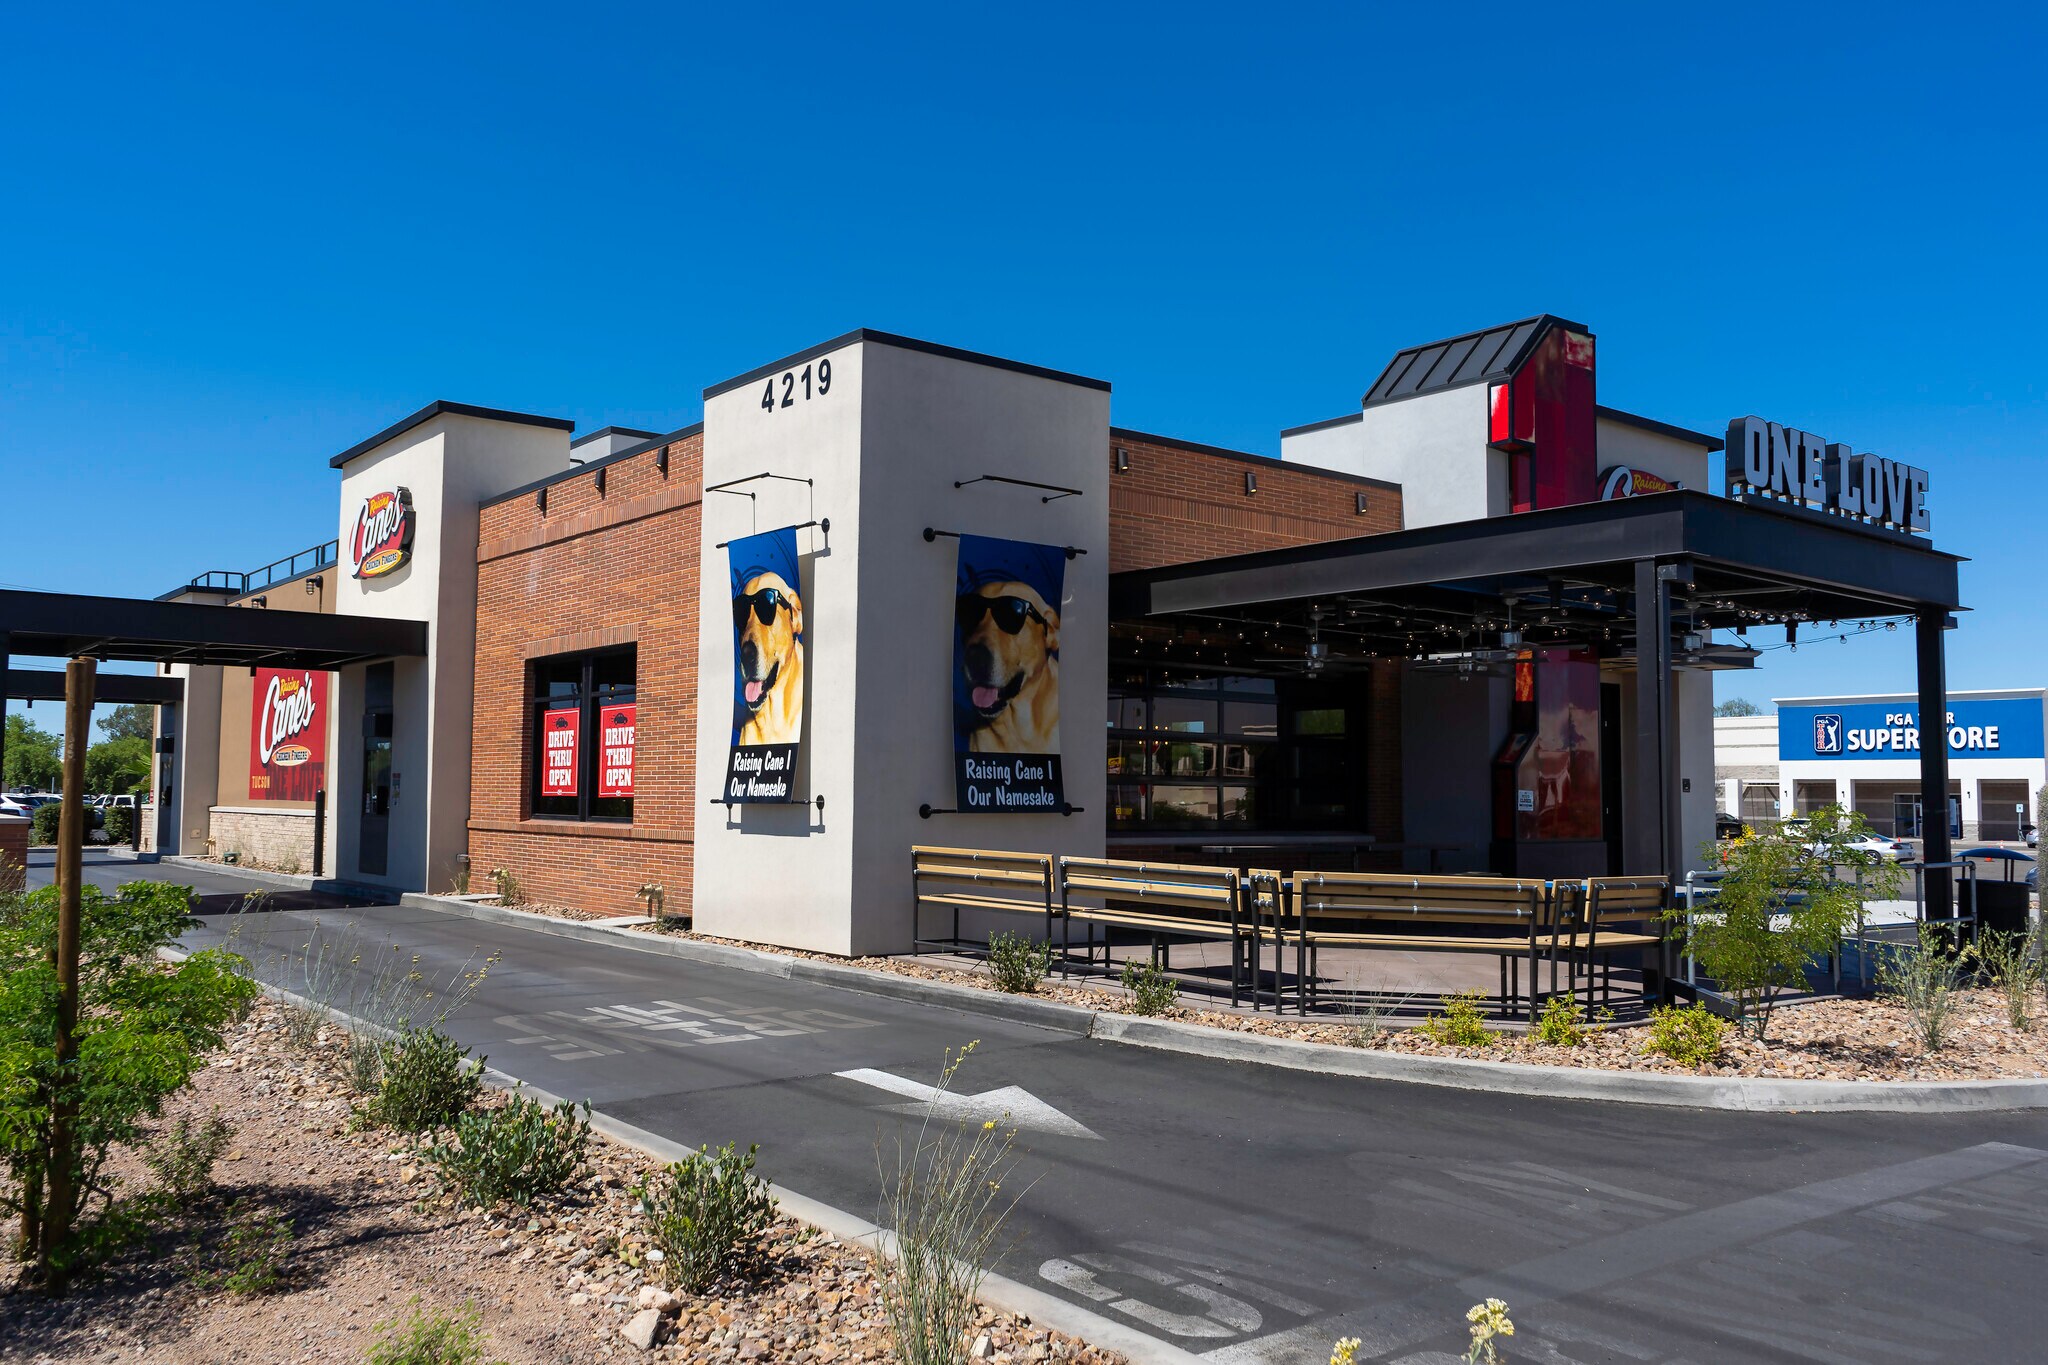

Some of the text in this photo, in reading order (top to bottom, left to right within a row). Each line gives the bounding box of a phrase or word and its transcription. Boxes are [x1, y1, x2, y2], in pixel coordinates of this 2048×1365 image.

[761, 358, 831, 413] 4219
[1742, 415, 1931, 532] ONE LOVE
[369, 494, 390, 516] Raising
[349, 486, 405, 577] Cane's
[280, 676, 300, 696] Raising
[260, 671, 316, 764] Cane's
[1886, 713, 1914, 726] PGA
[548, 729, 575, 748] DRIVE
[605, 726, 635, 746] DRIVE
[1847, 726, 2000, 751] SUPERORE
[548, 749, 573, 767] THRU
[606, 747, 633, 767] THRU
[733, 751, 763, 777] Raising
[764, 750, 785, 771] Cane
[252, 775, 271, 788] TUCSON
[548, 768, 572, 786] OPEN
[606, 768, 632, 787] OPEN
[965, 758, 1011, 785] Raising
[1015, 760, 1044, 780] Cane
[730, 776, 787, 797] Our Namesake
[967, 785, 1055, 806] Our Namesake
